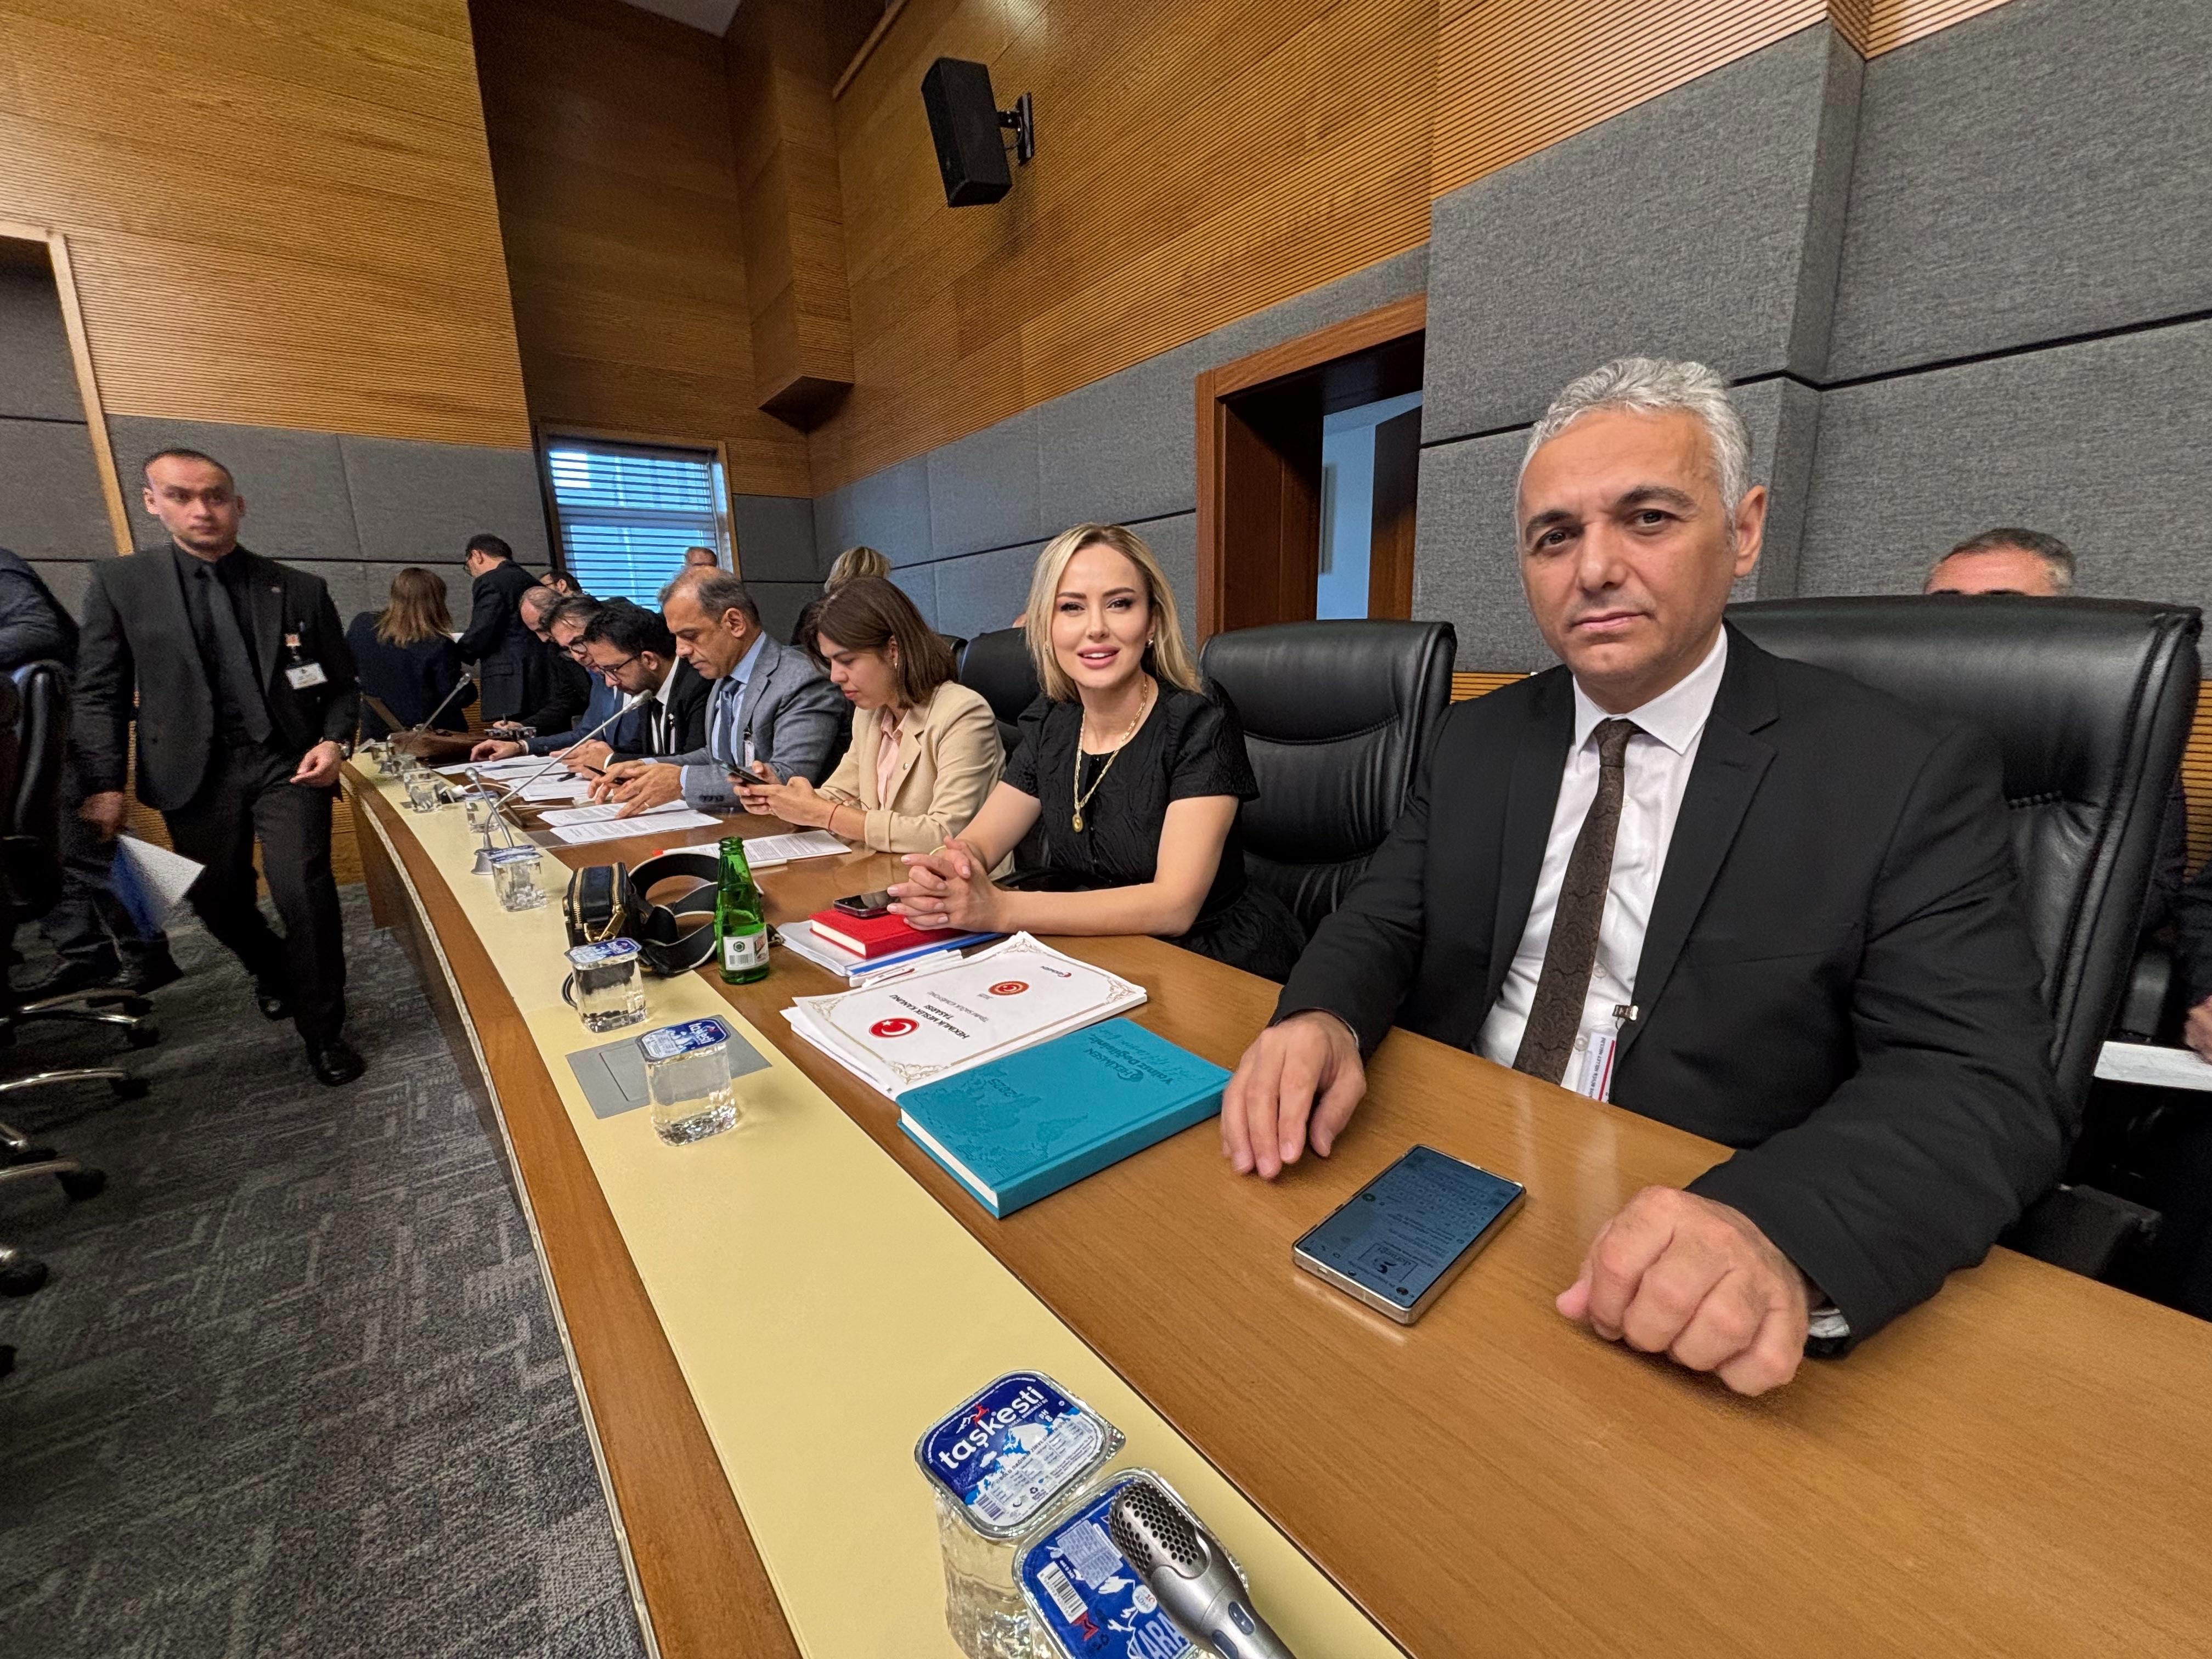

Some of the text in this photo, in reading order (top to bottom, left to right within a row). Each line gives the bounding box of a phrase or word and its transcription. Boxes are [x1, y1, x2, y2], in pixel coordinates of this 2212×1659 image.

[889, 995, 970, 1039] HEKİMLİK MESLEK KANUNU
[923, 1005, 954, 1020] TASARISI
[938, 1386, 1044, 1469] taşkesti
[999, 1469, 1012, 1480] BOLU
